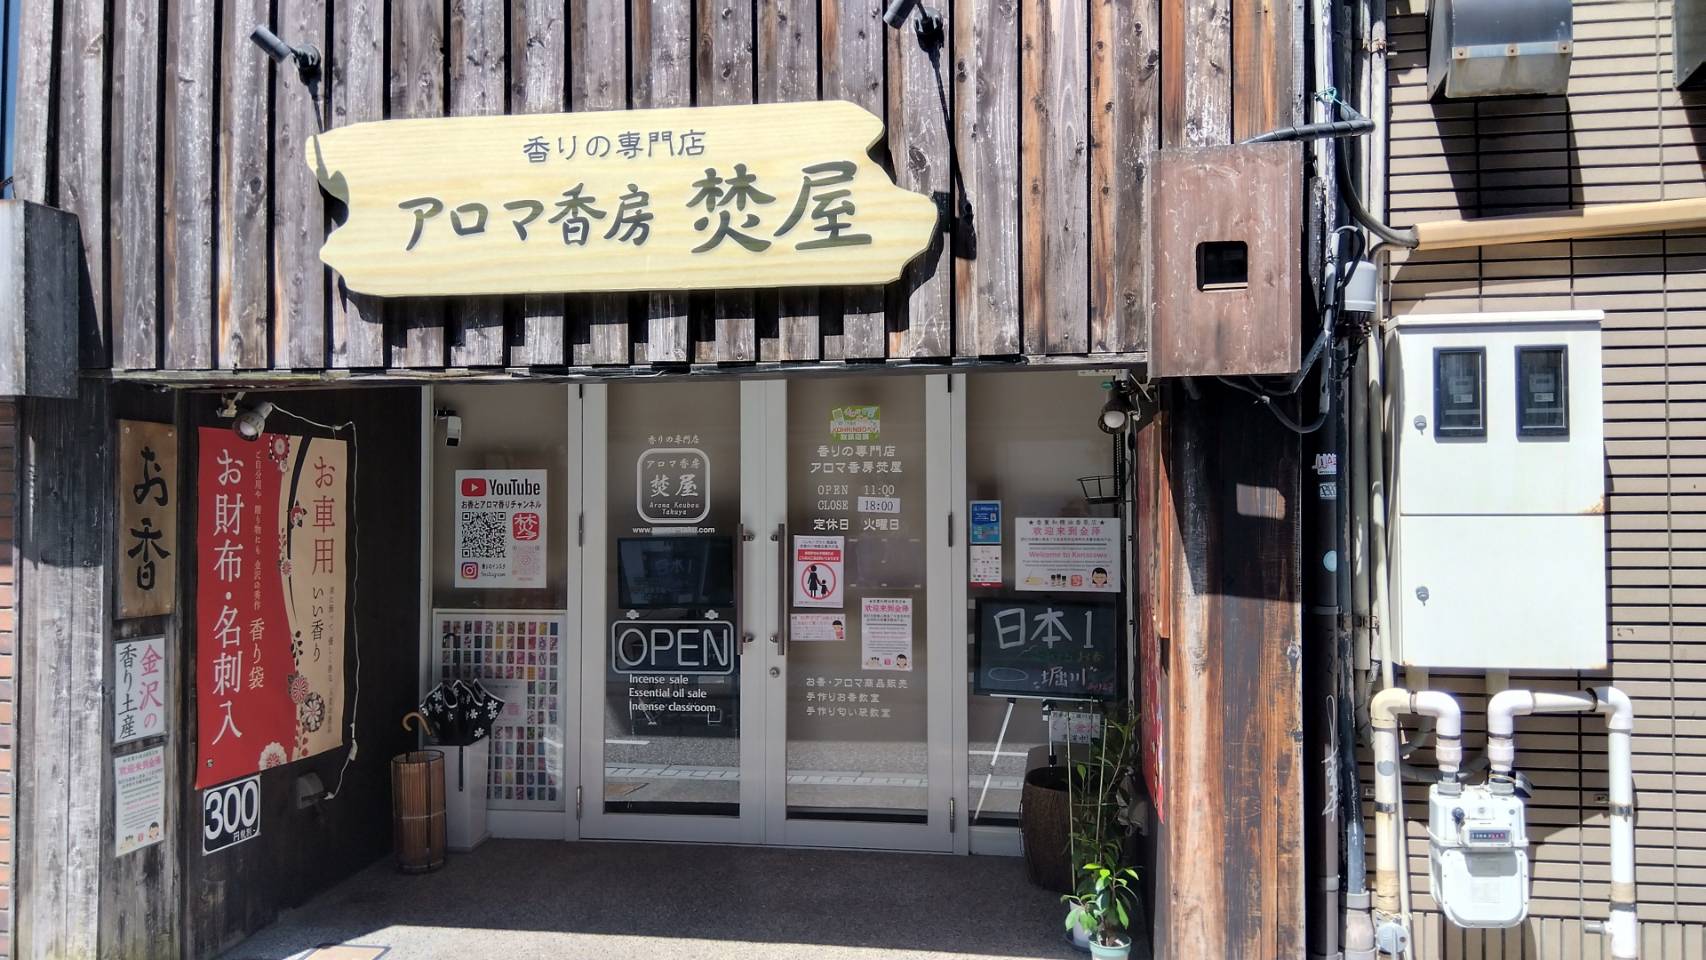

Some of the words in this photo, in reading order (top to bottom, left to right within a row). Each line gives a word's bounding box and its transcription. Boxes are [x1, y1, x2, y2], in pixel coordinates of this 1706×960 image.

[523, 129, 707, 163] 香りの専門店
[398, 182, 654, 252] アロマ香房
[685, 161, 872, 254] 焚屋
[648, 434, 700, 445] 香りの専門店
[817, 445, 896, 457] 香りの専門店
[646, 457, 701, 470] アロマ香房
[810, 460, 903, 474] アロマ香房焚屋
[489, 478, 541, 496] YouTube
[650, 473, 699, 498] 焚屋
[817, 484, 849, 495] OPEN
[863, 484, 895, 495] 11:00
[662, 508, 687, 516] Takuya
[817, 499, 849, 511] CLOSE
[864, 500, 894, 511] 18:00
[127, 446, 171, 591] お香
[311, 456, 336, 576] お車用
[813, 518, 849, 531] 定休日
[863, 517, 900, 531] 火曜日
[311, 586, 324, 663] いい香り
[248, 618, 265, 690] 香り袋
[618, 628, 728, 666] OPEN
[629, 673, 665, 684] Incense
[669, 675, 689, 685] sale
[806, 677, 908, 689] お香・アロマ商品販売
[117, 643, 138, 740] 香り土産
[139, 644, 163, 729] 金沢の
[629, 687, 670, 698] Essential
[672, 688, 685, 698] oil
[687, 689, 707, 699] sale
[806, 691, 880, 703] 手作りお香教室
[629, 701, 665, 712] Incense
[668, 702, 716, 712] classroom
[205, 780, 258, 840] 300
